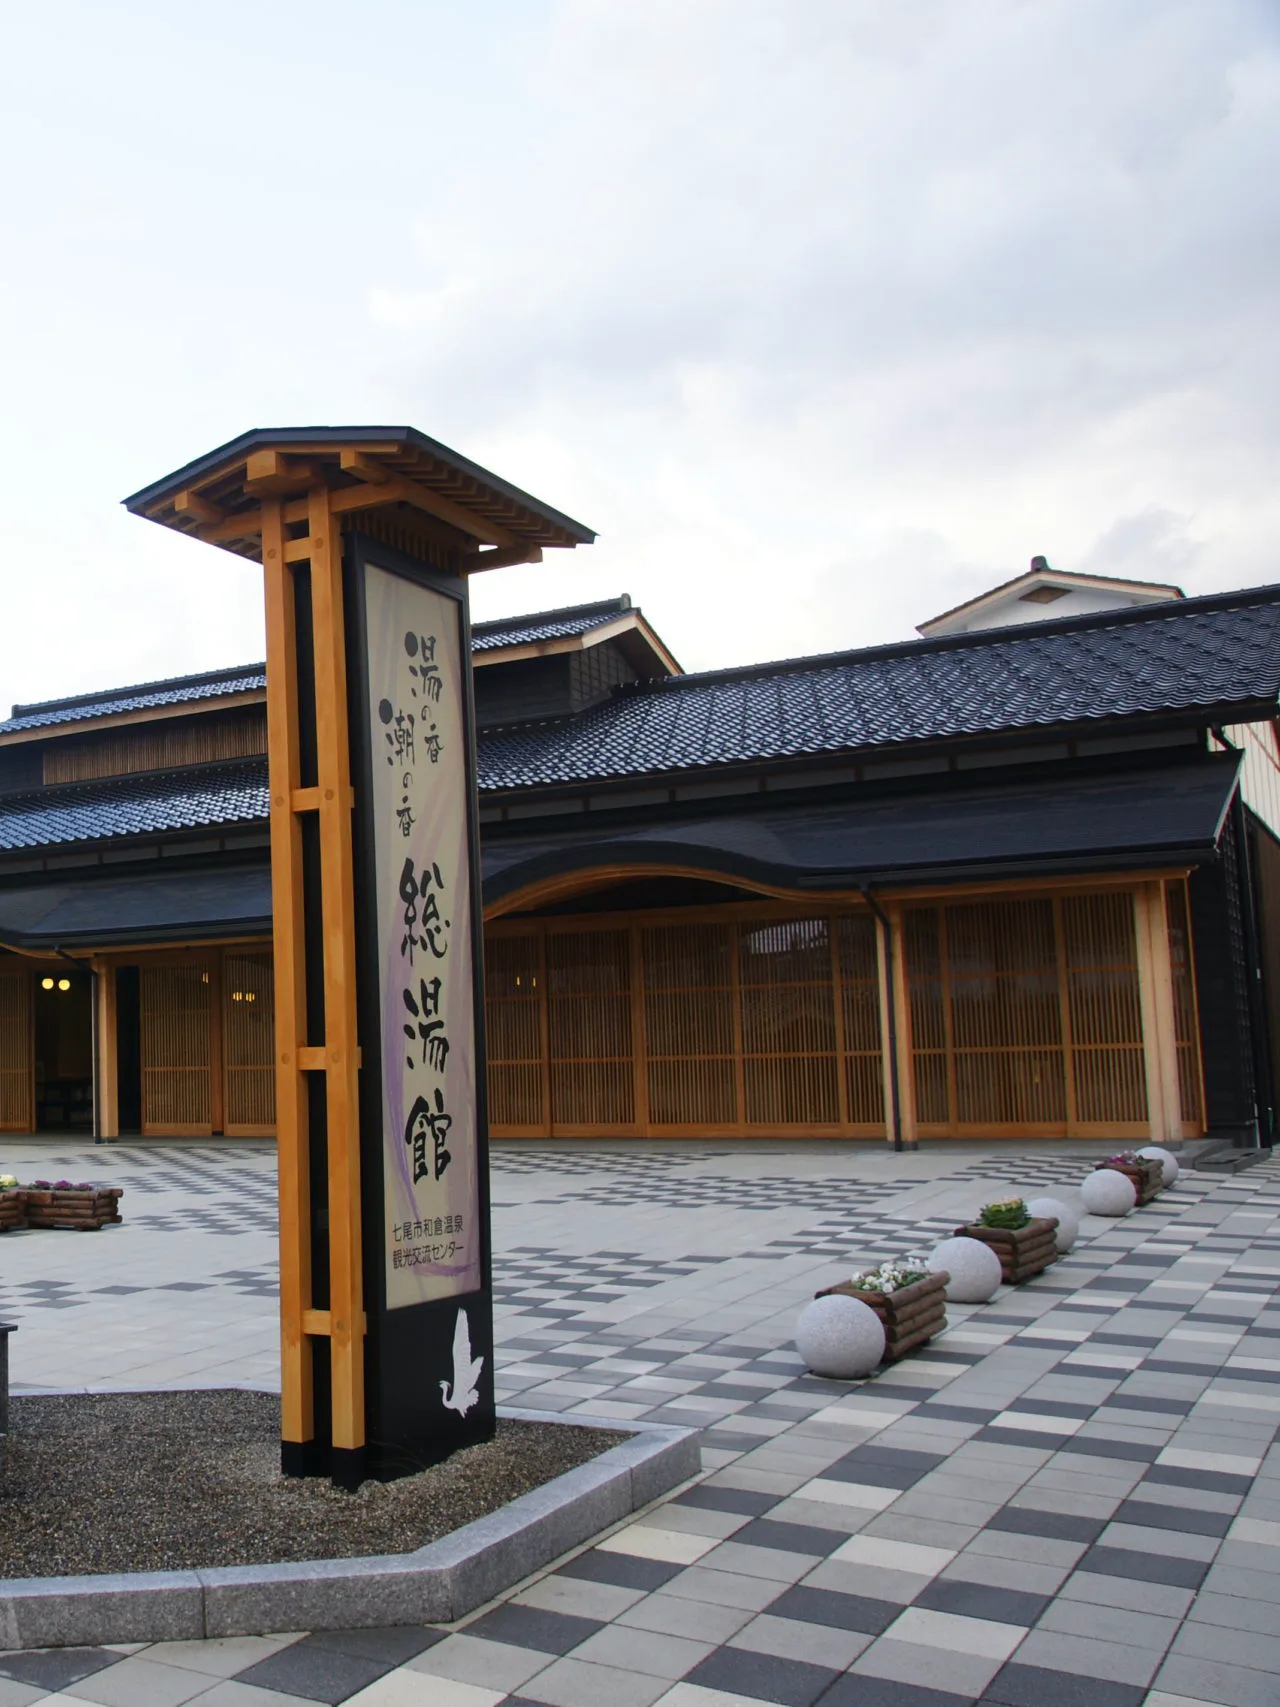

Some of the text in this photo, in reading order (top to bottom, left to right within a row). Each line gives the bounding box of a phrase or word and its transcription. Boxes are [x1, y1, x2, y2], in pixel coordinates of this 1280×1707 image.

[405, 632, 444, 763] 湯の香
[379, 699, 416, 837] 潮の香
[399, 858, 452, 1183] 総湯館
[393, 1215, 463, 1242] 七尾市和倉温泉
[393, 1241, 464, 1269] 観光交流センター
